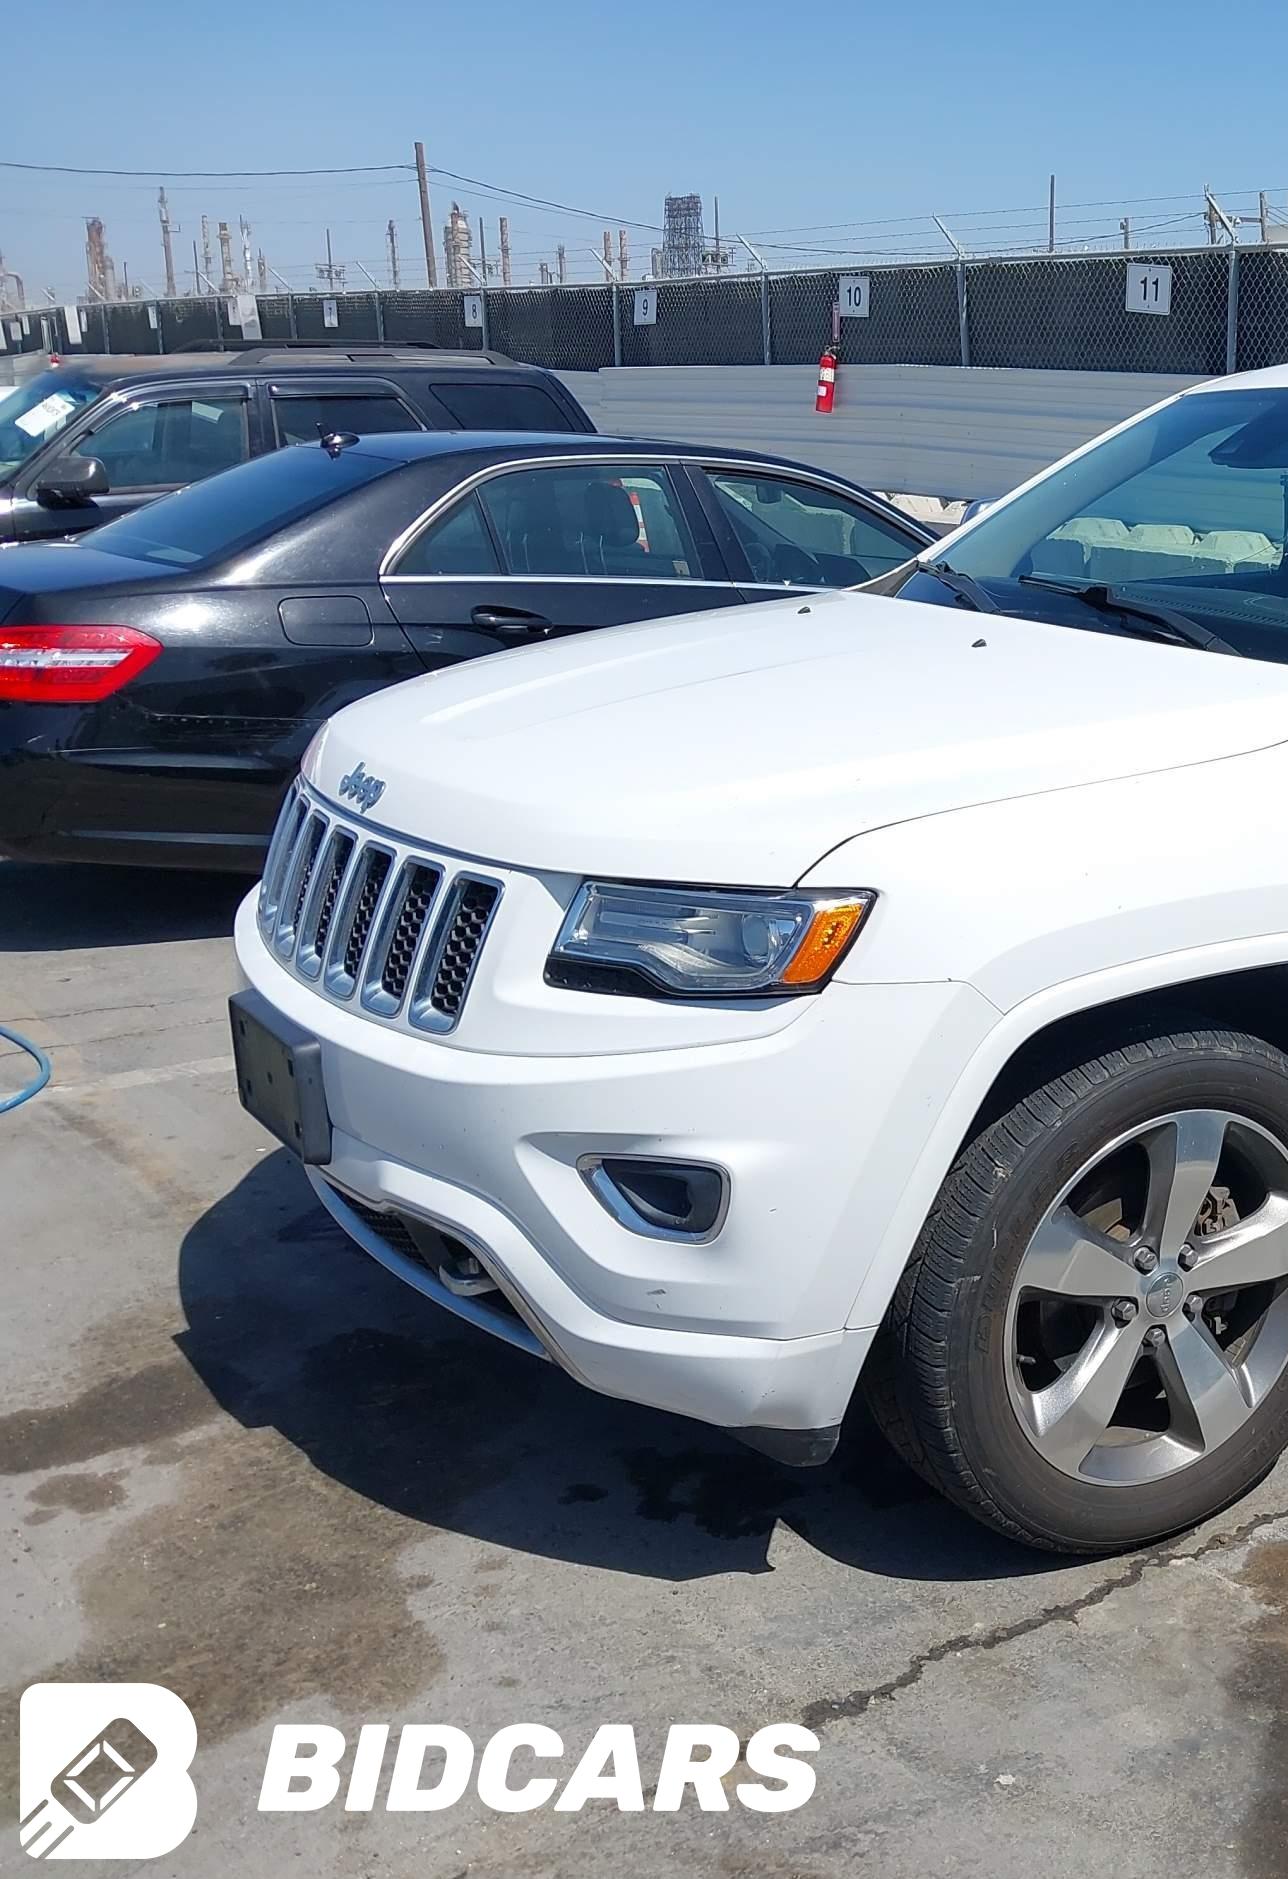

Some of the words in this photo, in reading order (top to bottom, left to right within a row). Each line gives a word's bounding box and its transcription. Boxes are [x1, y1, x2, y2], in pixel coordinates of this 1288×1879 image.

[846, 286, 862, 307] 10
[1140, 276, 1159, 302] 11
[471, 303, 478, 320] 8
[642, 298, 649, 317] 9
